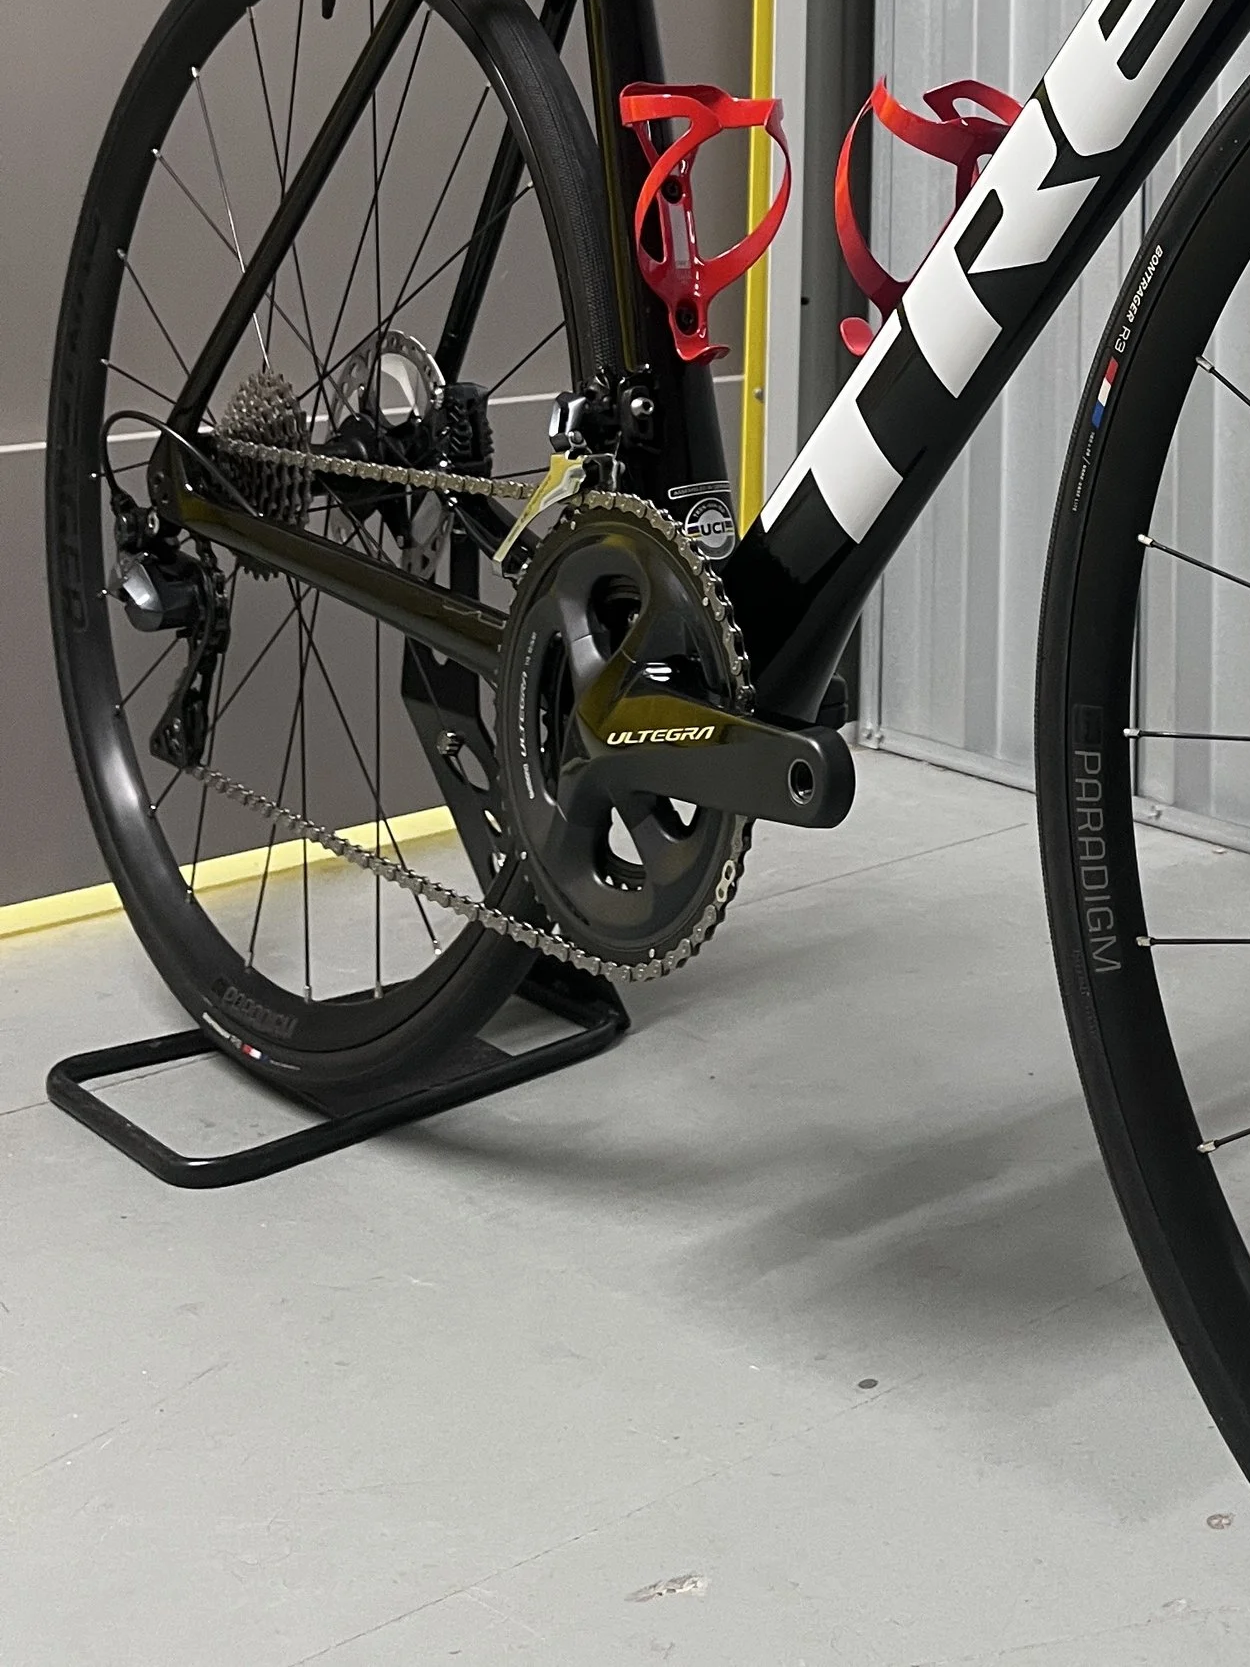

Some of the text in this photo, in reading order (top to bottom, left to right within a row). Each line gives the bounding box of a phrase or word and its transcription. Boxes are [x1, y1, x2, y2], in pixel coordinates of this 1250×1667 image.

[1114, 244, 1164, 354] BONTRAGER R3
[700, 522, 725, 536] UCI
[606, 725, 715, 745] ULTEGRA
[1074, 749, 1122, 973] PARADIGM
